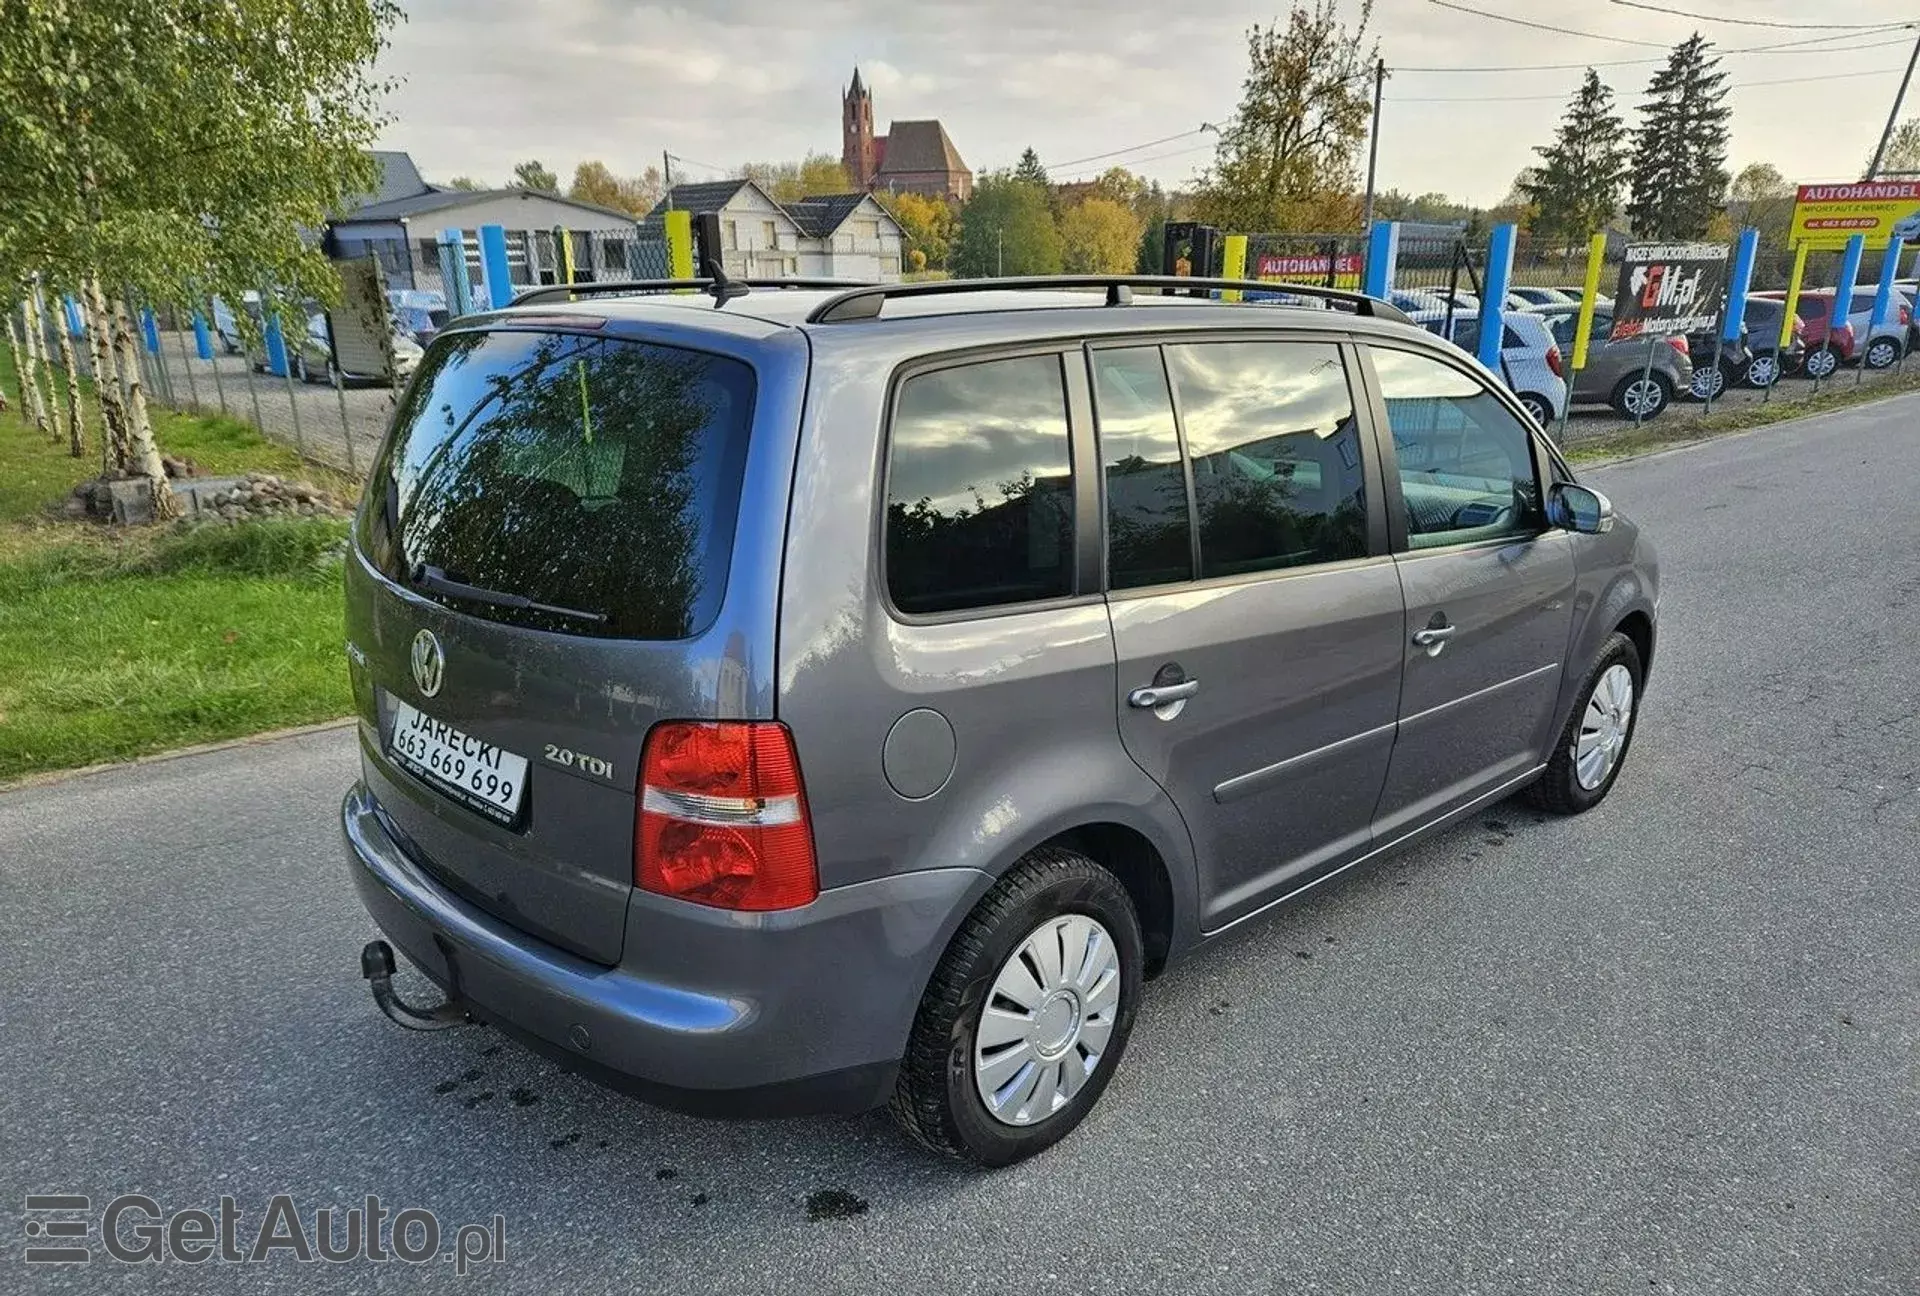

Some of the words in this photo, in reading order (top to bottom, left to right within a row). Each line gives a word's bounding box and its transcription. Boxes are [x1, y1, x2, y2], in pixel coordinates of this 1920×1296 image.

[1804, 185, 1918, 200] AUTOHANDEL
[410, 711, 503, 770] JARECKI
[398, 729, 426, 759] 663
[430, 748, 465, 780] 669
[471, 769, 513, 803] 699
[575, 752, 614, 780] TDI
